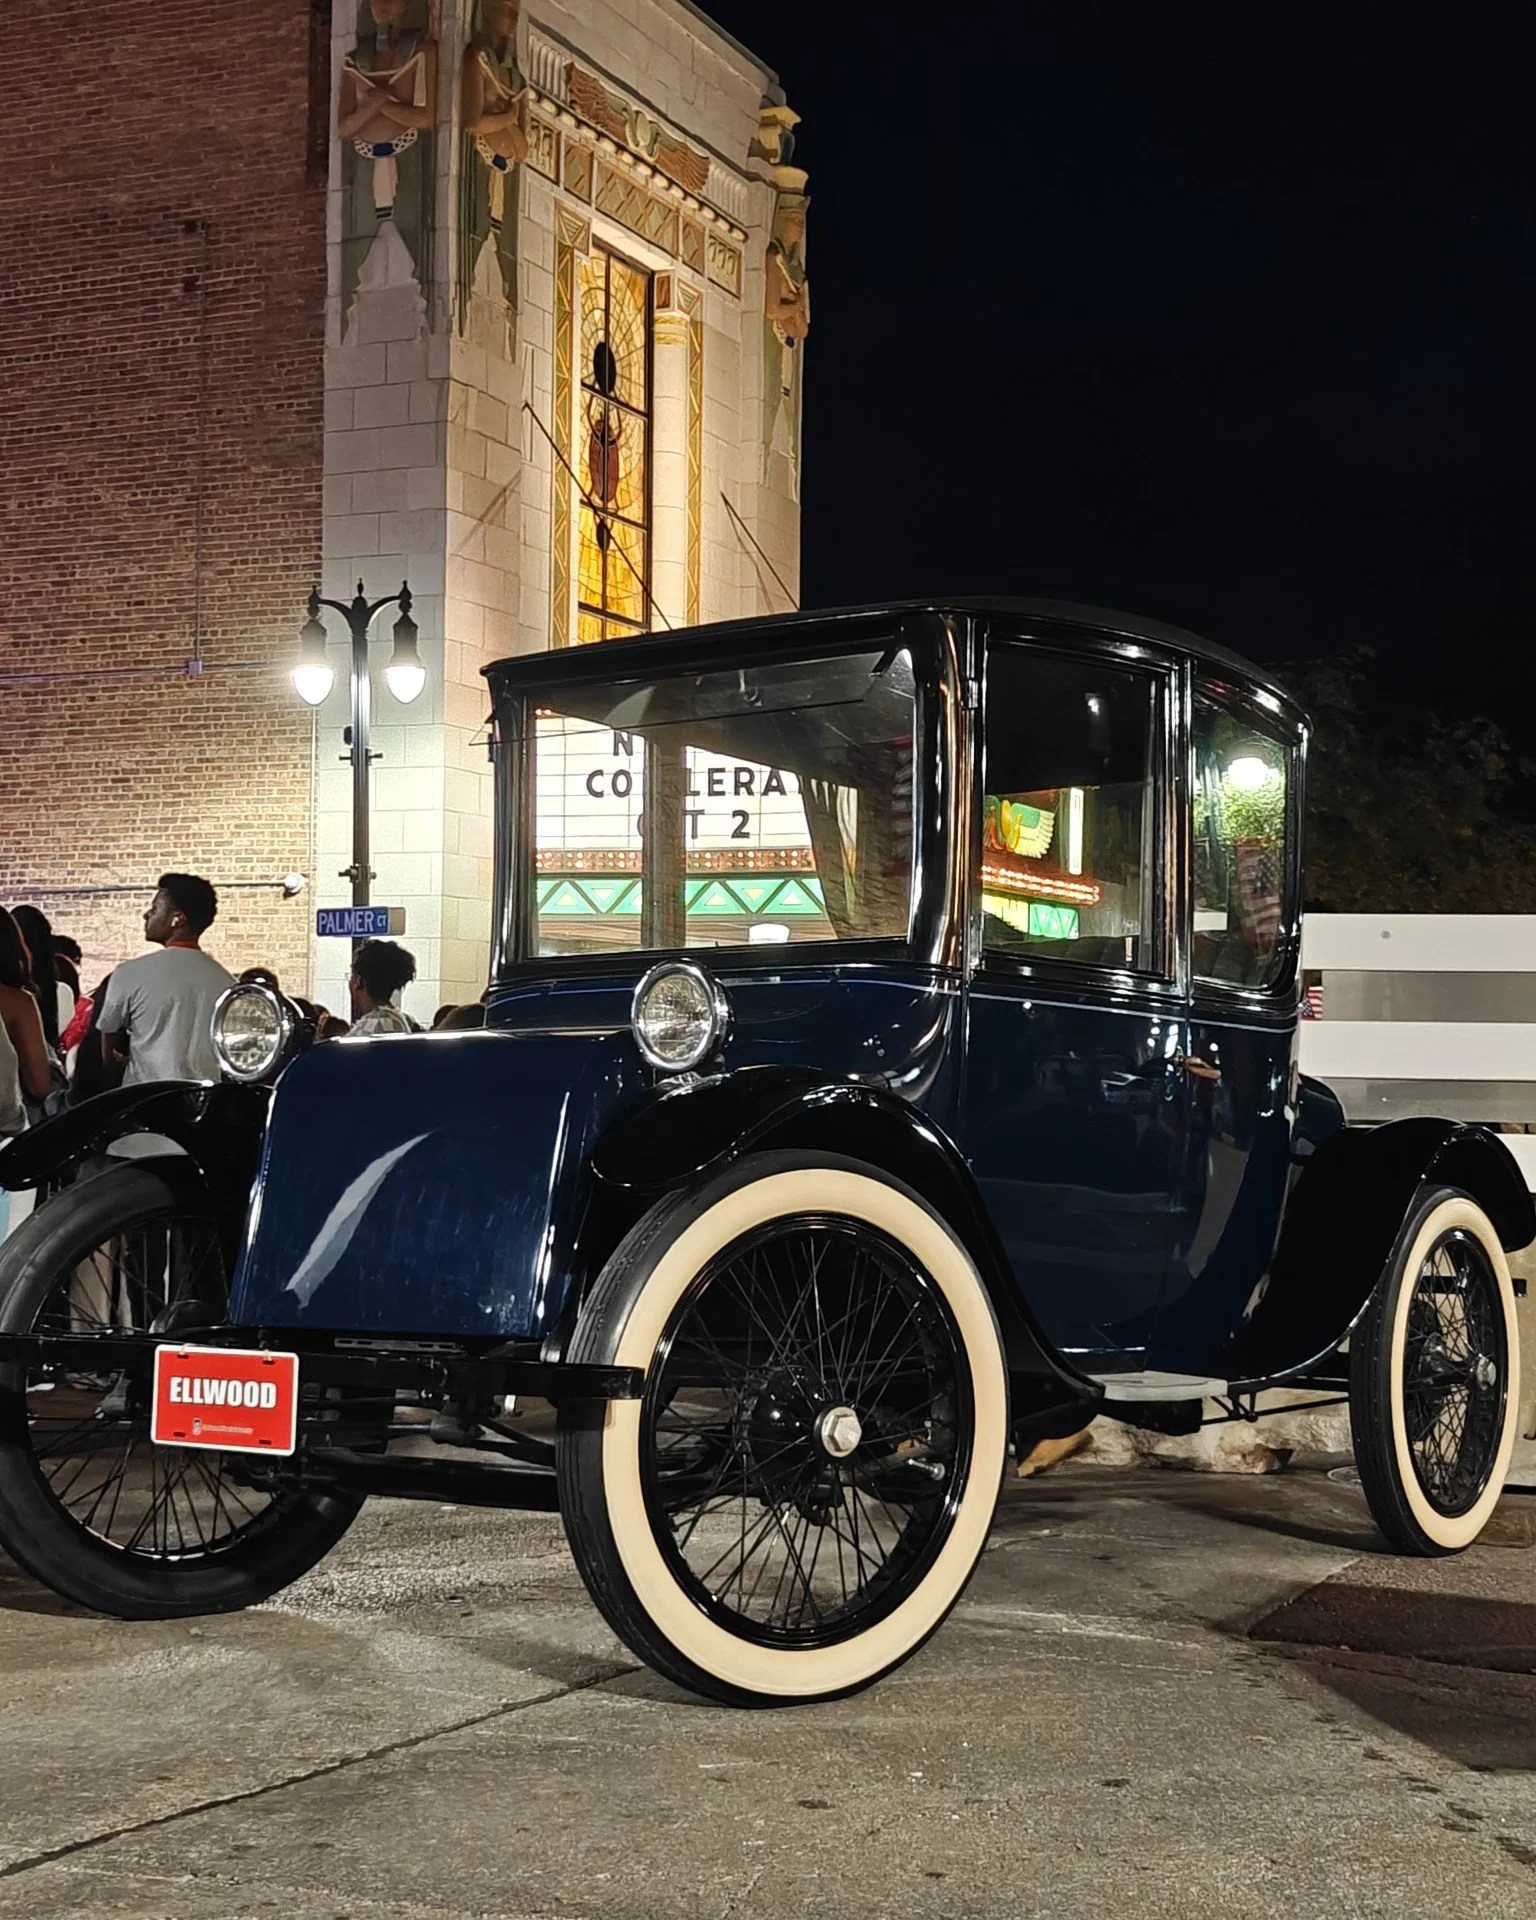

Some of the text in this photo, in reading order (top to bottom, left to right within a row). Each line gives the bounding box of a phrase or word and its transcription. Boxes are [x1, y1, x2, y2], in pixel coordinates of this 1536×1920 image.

[731, 810, 750, 839] 2
[319, 911, 386, 934] PALMER CT
[169, 1376, 277, 1408] ELLWOOD
